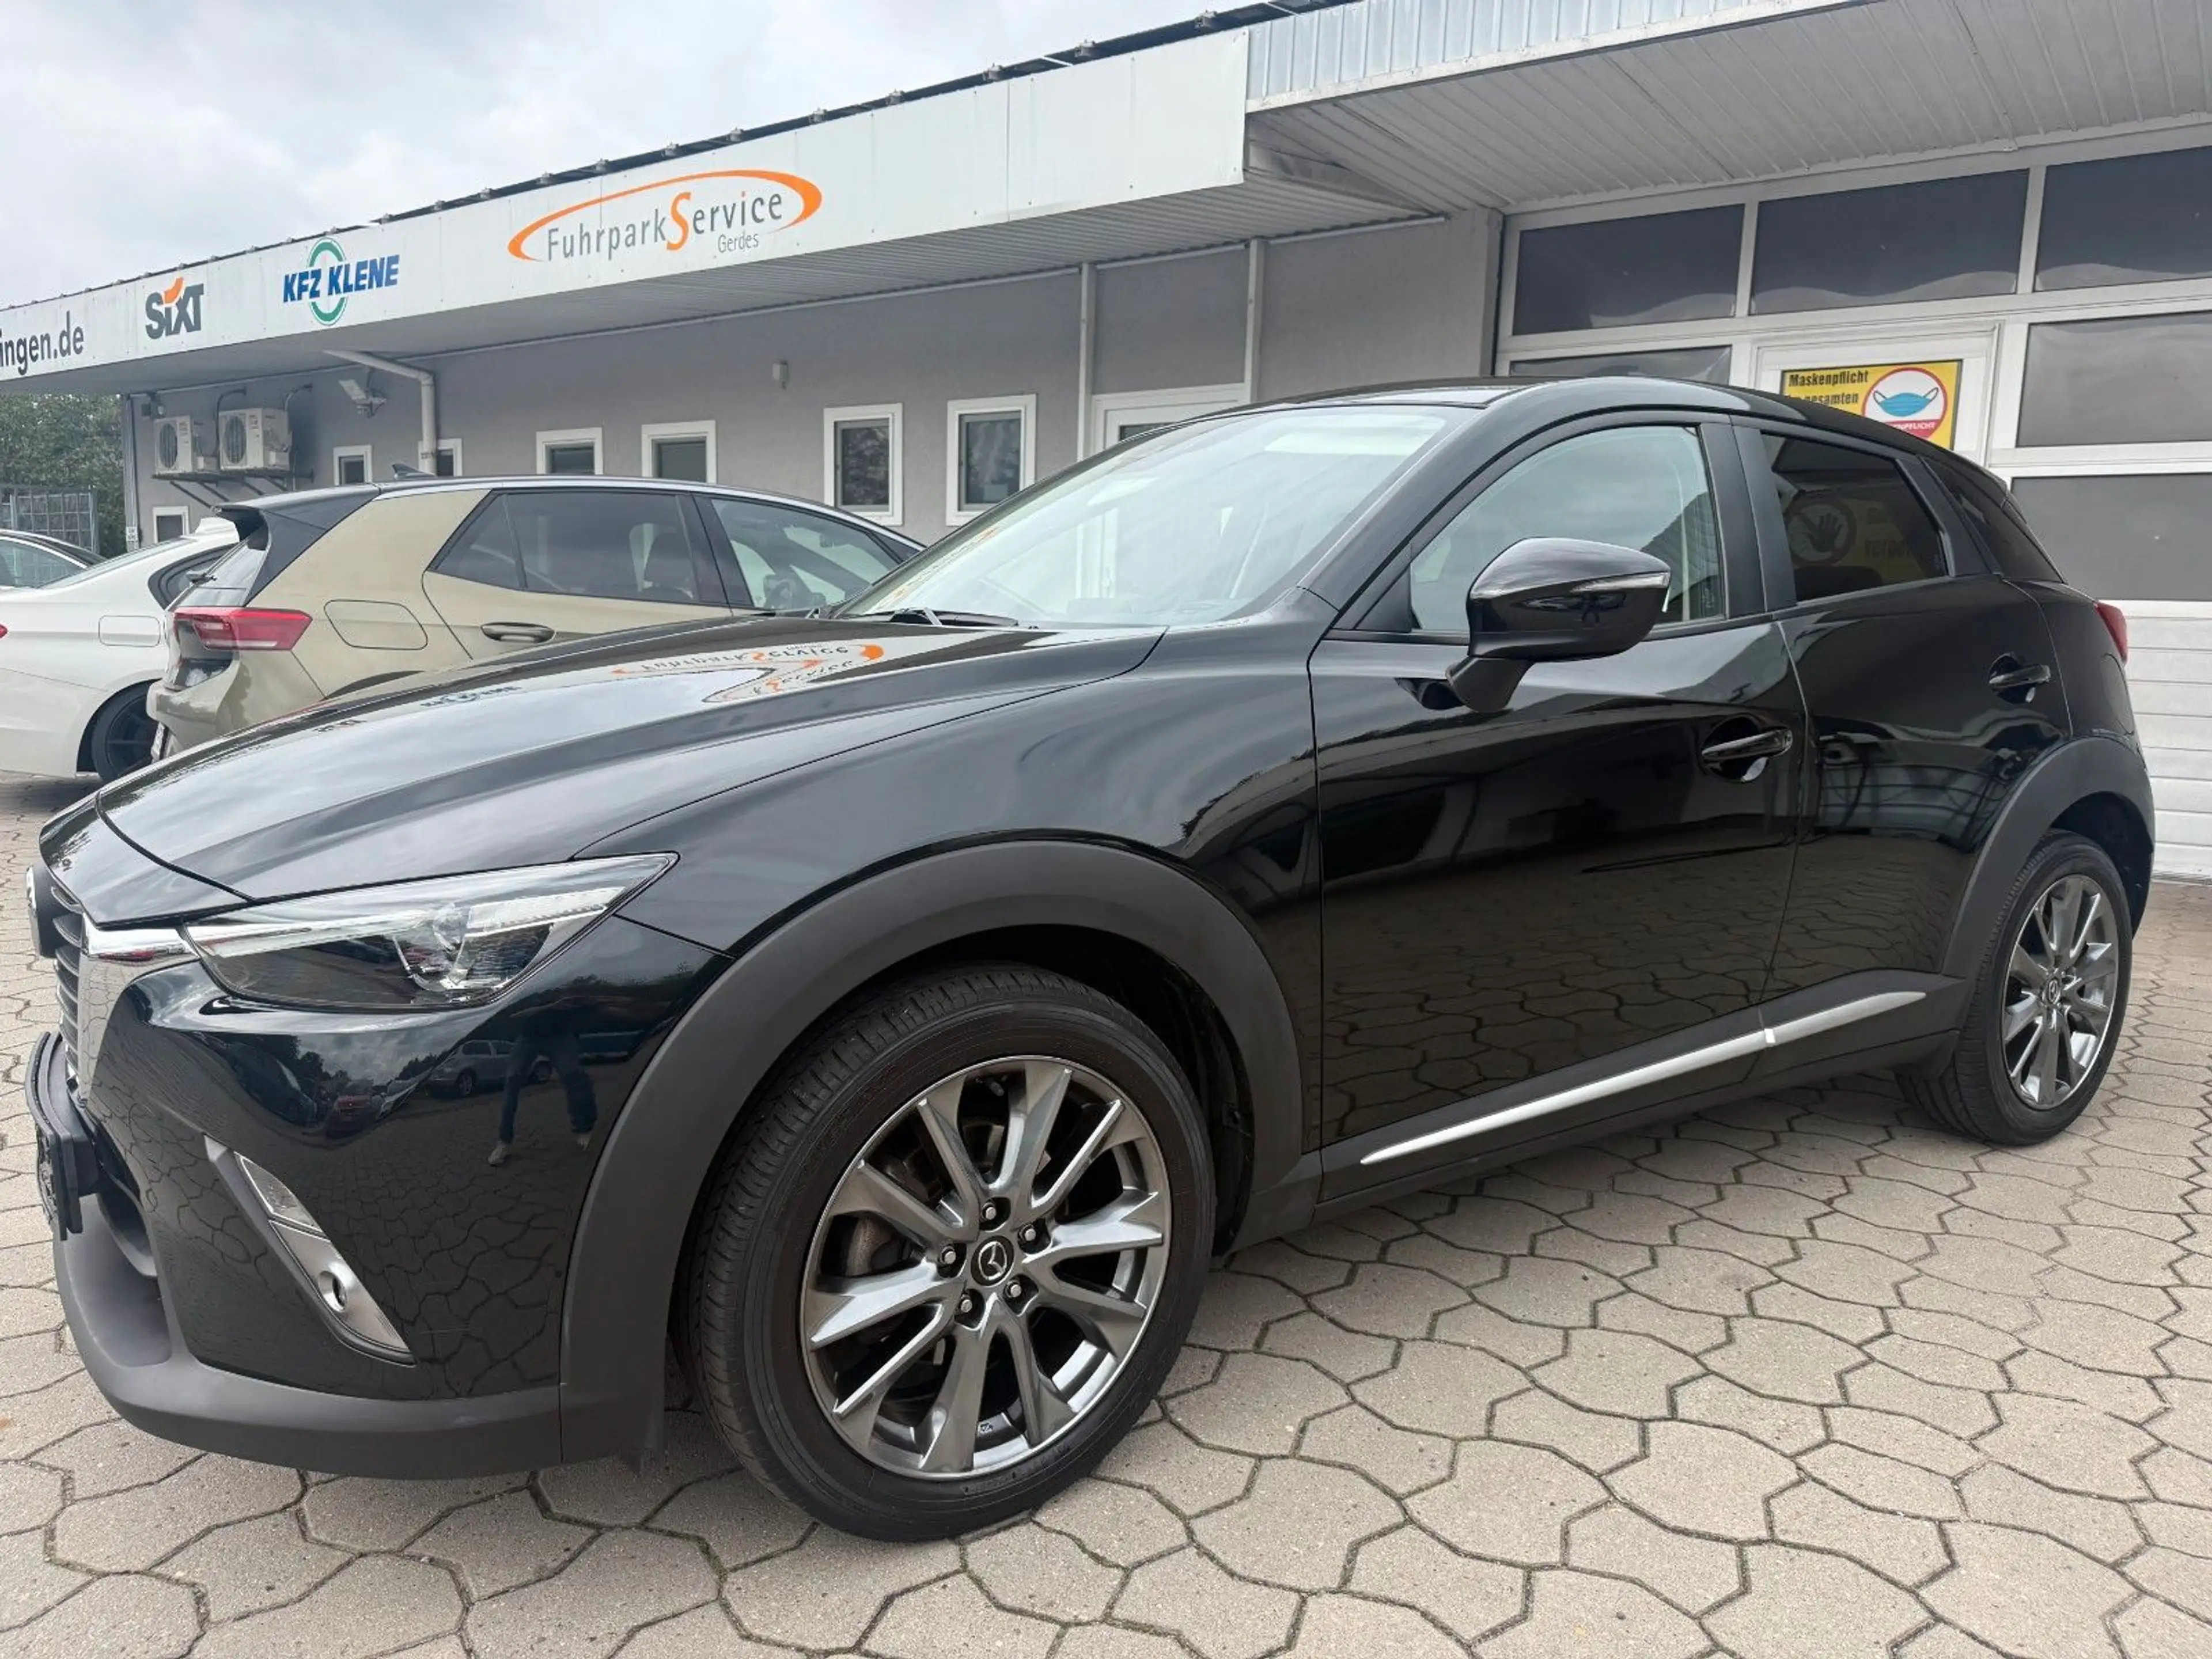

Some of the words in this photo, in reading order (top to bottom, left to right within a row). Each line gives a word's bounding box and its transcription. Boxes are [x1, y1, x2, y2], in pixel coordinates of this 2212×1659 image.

[718, 233, 759, 253] Gerdes
[283, 269, 321, 302] KFZ
[328, 255, 400, 296] KLENE
[1789, 371, 1868, 387] Maskenpflicht
[1804, 393, 1859, 406] esamten
